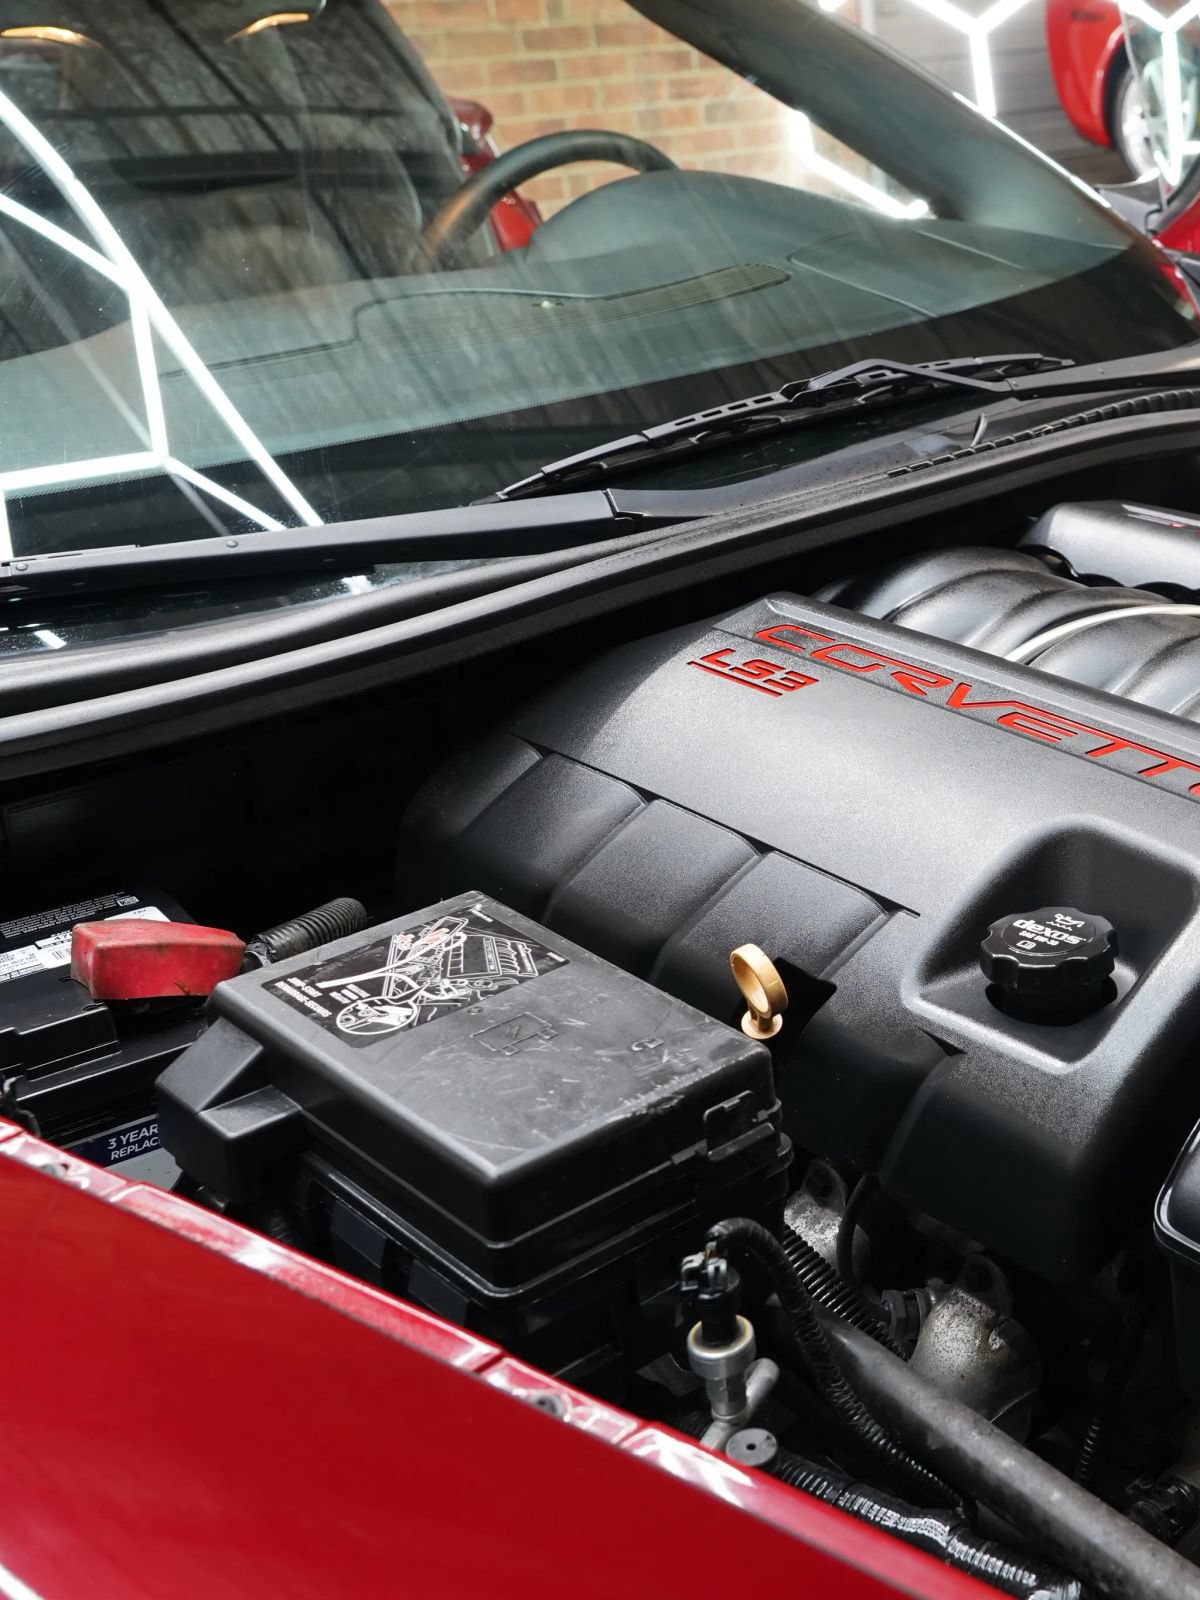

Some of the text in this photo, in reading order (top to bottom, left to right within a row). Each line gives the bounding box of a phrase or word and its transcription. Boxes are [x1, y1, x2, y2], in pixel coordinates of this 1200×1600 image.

[690, 647, 819, 697] LS3
[1012, 919, 1081, 945] dexos
[107, 1123, 159, 1150] 3 YEAR
[110, 1136, 160, 1161] REPLAC
